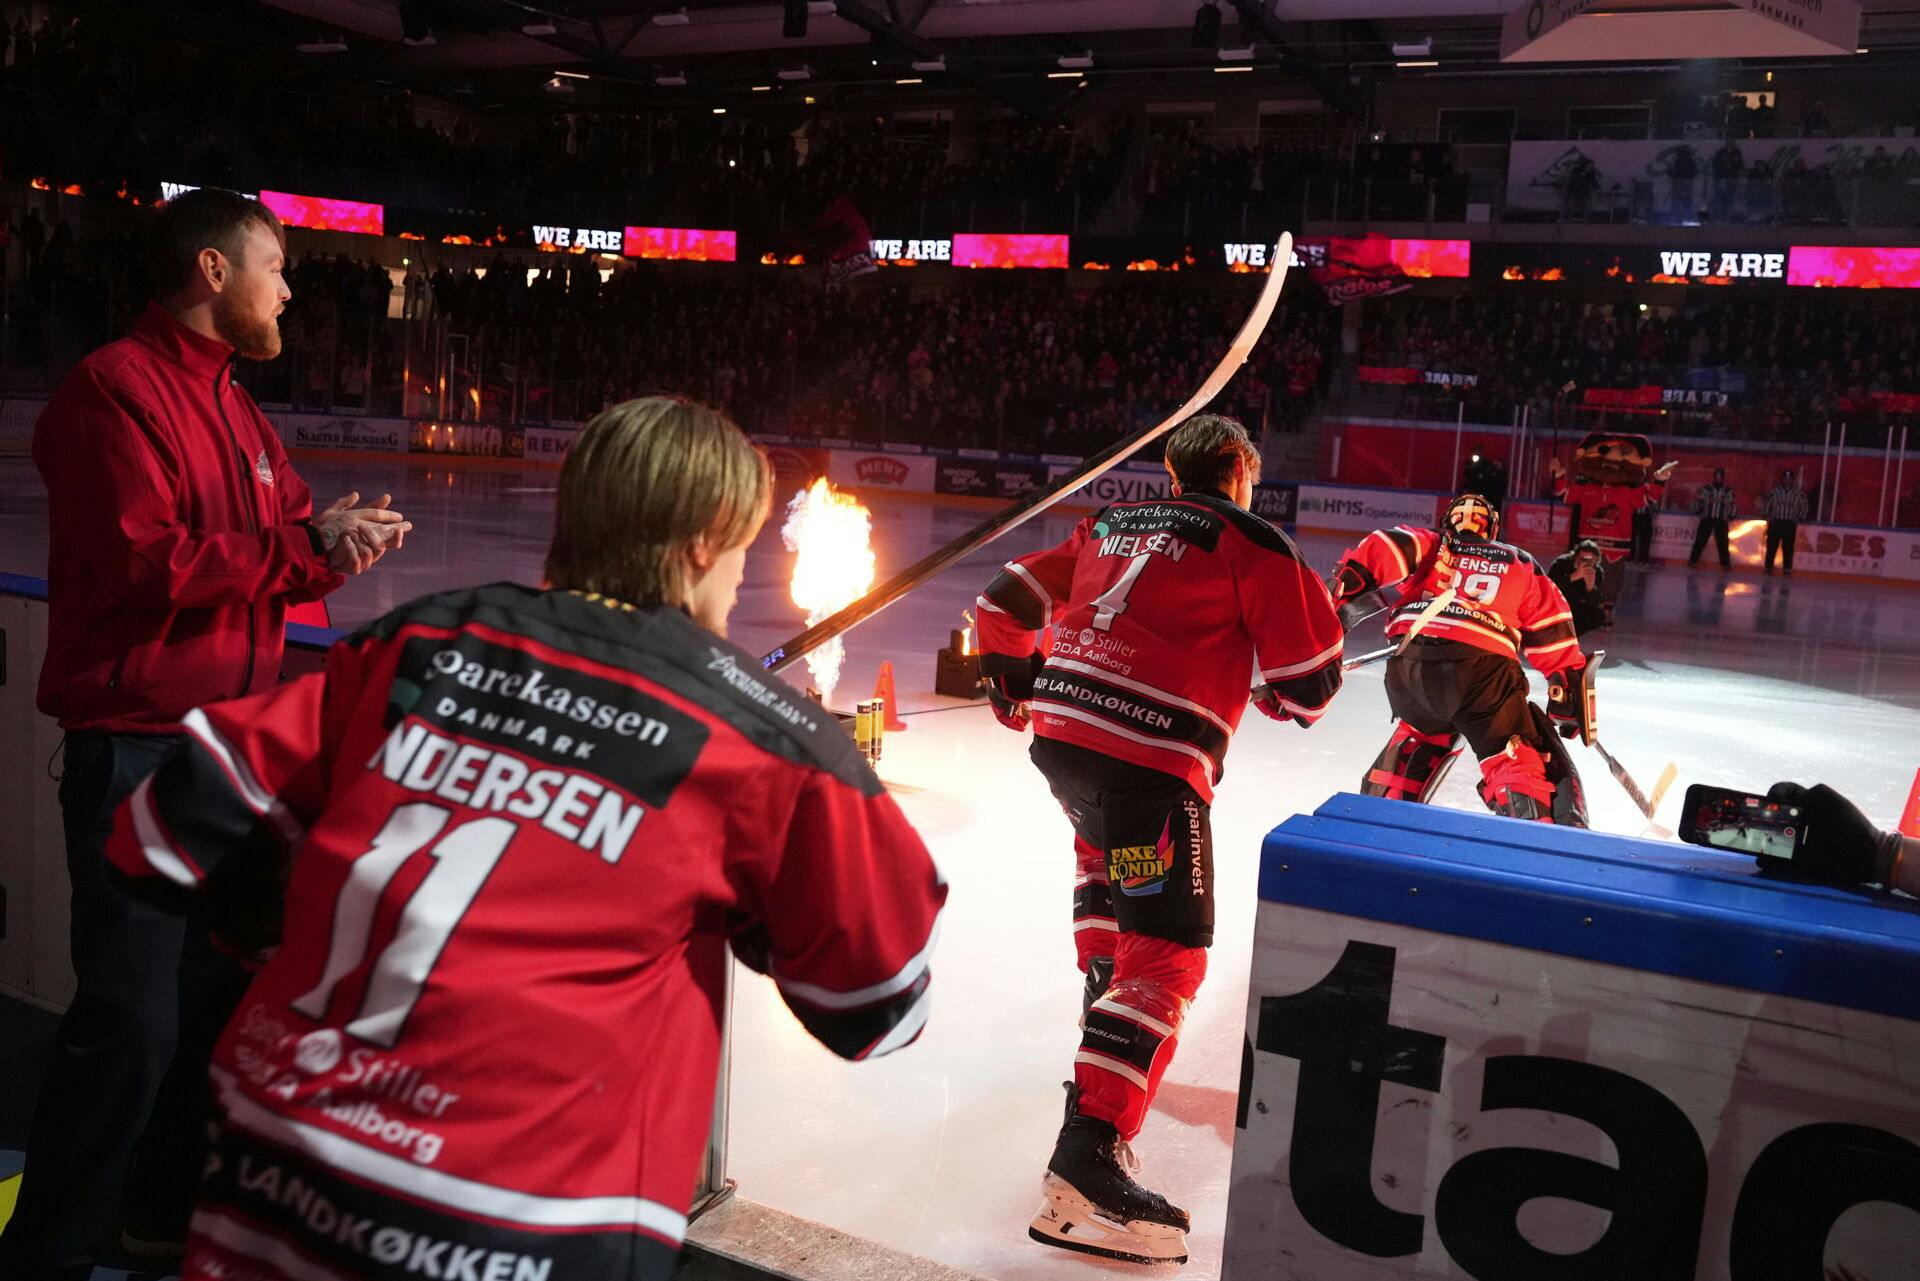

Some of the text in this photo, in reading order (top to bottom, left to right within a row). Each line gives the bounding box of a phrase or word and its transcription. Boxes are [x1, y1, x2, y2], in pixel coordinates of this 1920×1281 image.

[532, 226, 623, 251] WE ARE
[869, 239, 951, 260] WE ARE
[1223, 243, 1267, 266] WE
[1659, 251, 1785, 278] WE ARE
[1110, 505, 1213, 531] Sparekassen
[1323, 499, 1433, 524] HMS Opbevaring
[1120, 520, 1184, 532] DANMARK
[1097, 532, 1188, 563] NIELSEN
[1091, 553, 1152, 632] 4
[1095, 633, 1138, 659] Stiller
[1083, 649, 1133, 676] Aalborg
[1048, 679, 1173, 730] LANDKØKKEN
[436, 696, 598, 761] DANMARK
[1111, 845, 1157, 864] FAXE
[1109, 861, 1164, 881] KONDI
[290, 801, 519, 1051] 11
